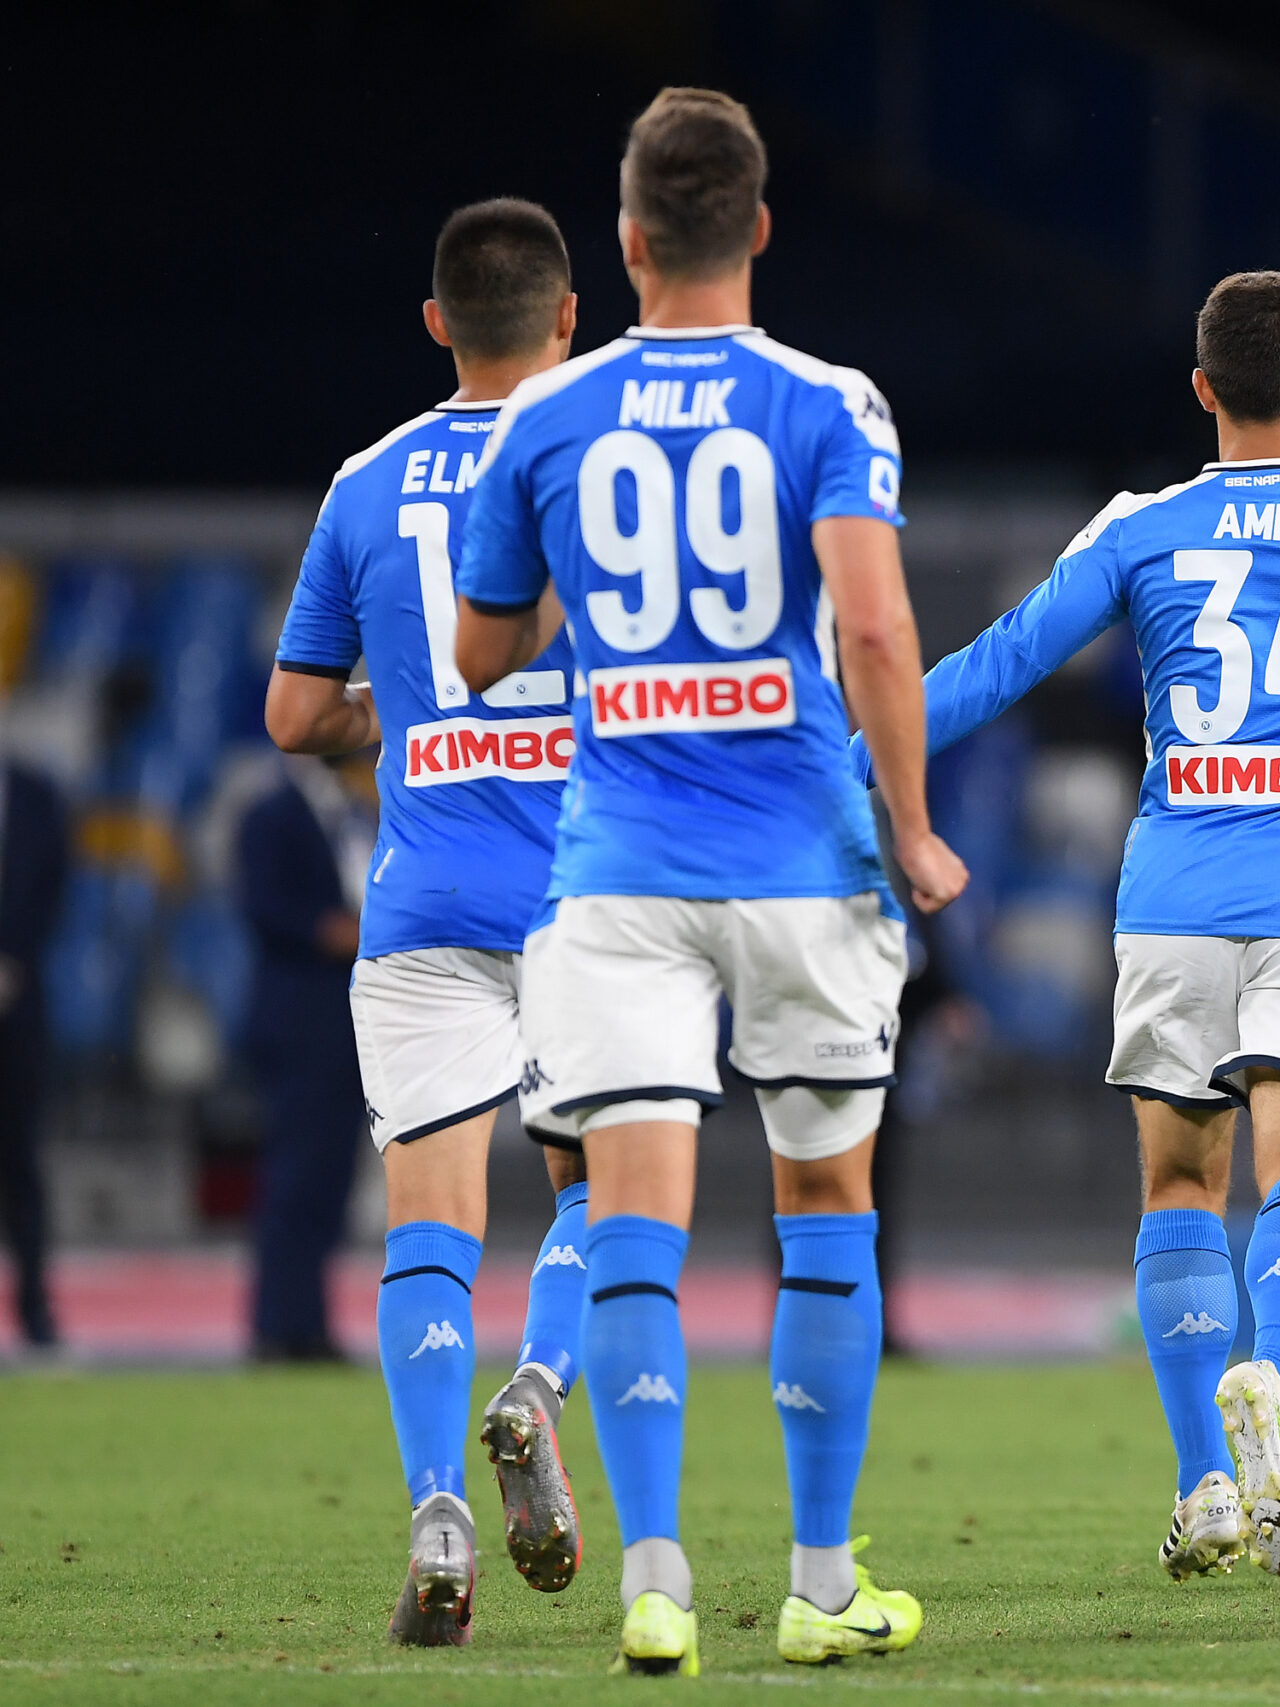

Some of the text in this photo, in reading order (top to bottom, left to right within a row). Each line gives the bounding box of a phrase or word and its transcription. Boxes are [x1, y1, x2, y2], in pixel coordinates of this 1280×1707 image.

[619, 377, 737, 429] MILIK
[1224, 477, 1252, 487] SSC
[577, 427, 783, 653] 99
[594, 673, 787, 724] KIMBO
